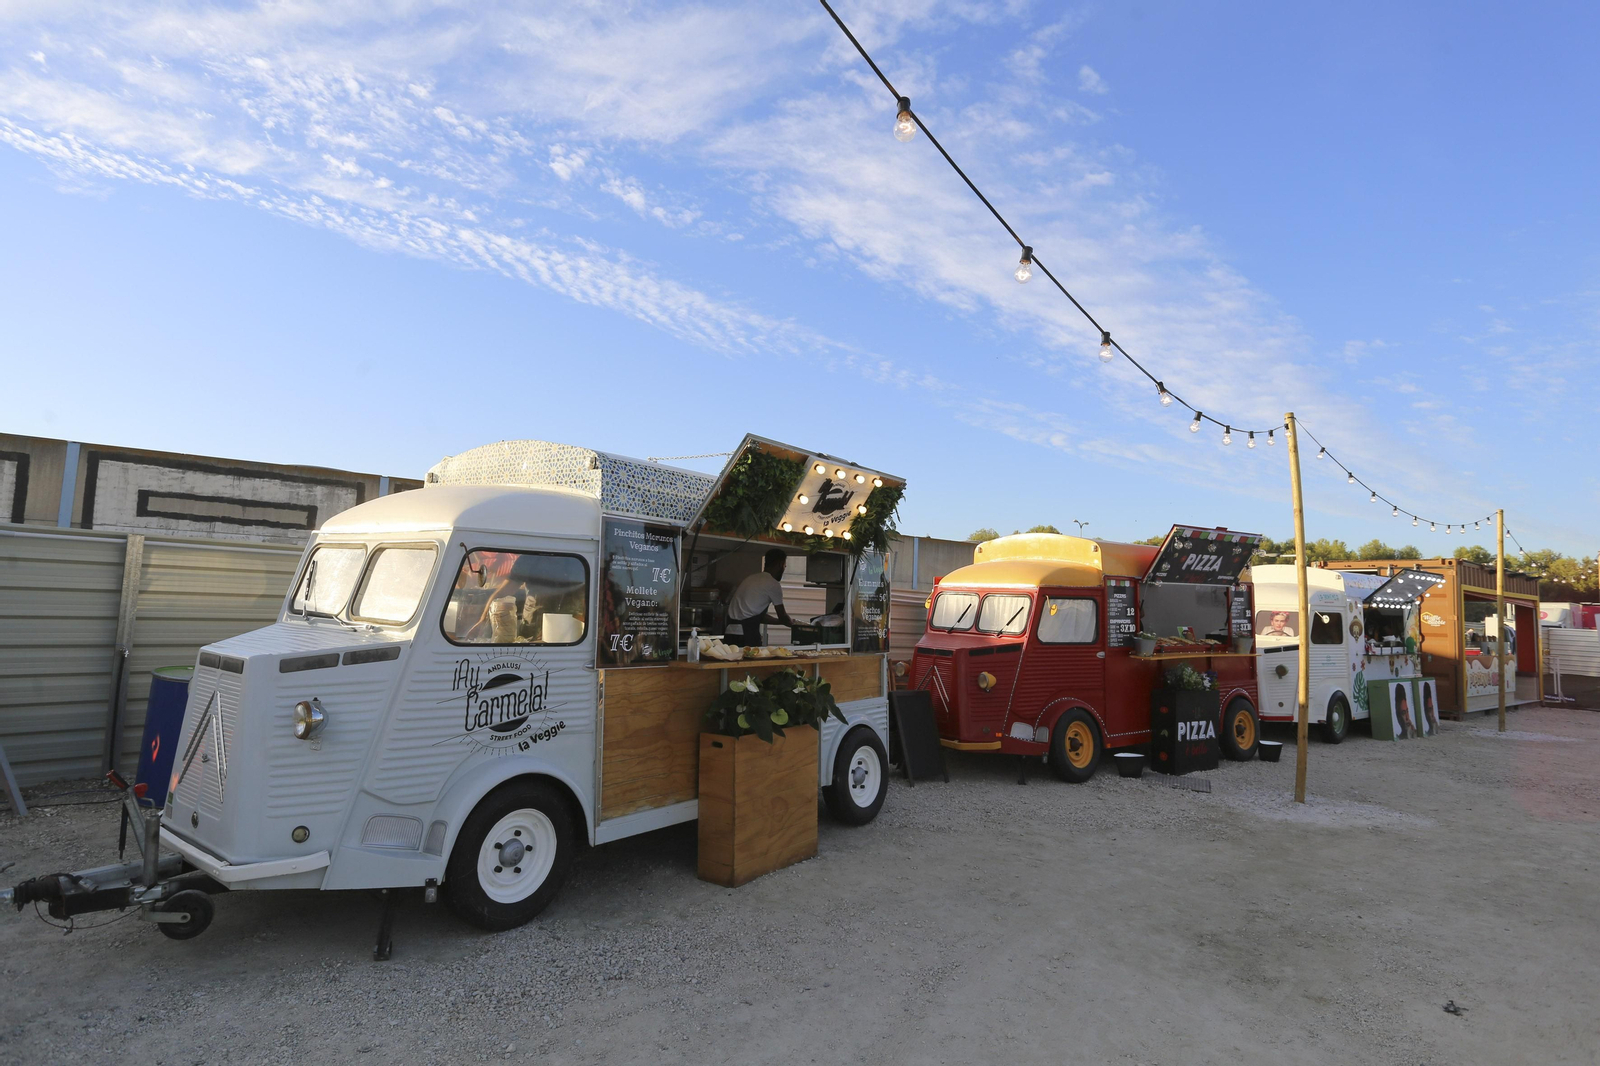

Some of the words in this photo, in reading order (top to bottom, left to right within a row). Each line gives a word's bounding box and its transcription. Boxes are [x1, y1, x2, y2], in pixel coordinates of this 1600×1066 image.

[614, 528, 645, 539] Pinchitos
[645, 533, 674, 543] Morunos
[629, 541, 659, 552] Veganos
[1181, 553, 1224, 572] PIZZA
[652, 567, 672, 583] 7€
[626, 585, 658, 596] Mollete
[625, 597, 658, 609] Vegano:
[1126, 607, 1135, 616] 12
[610, 633, 634, 652] 7€
[464, 670, 549, 732] Carmela!
[490, 734, 513, 742] STREET
[513, 723, 532, 739] FOOD
[1177, 720, 1216, 742] PIZZA
